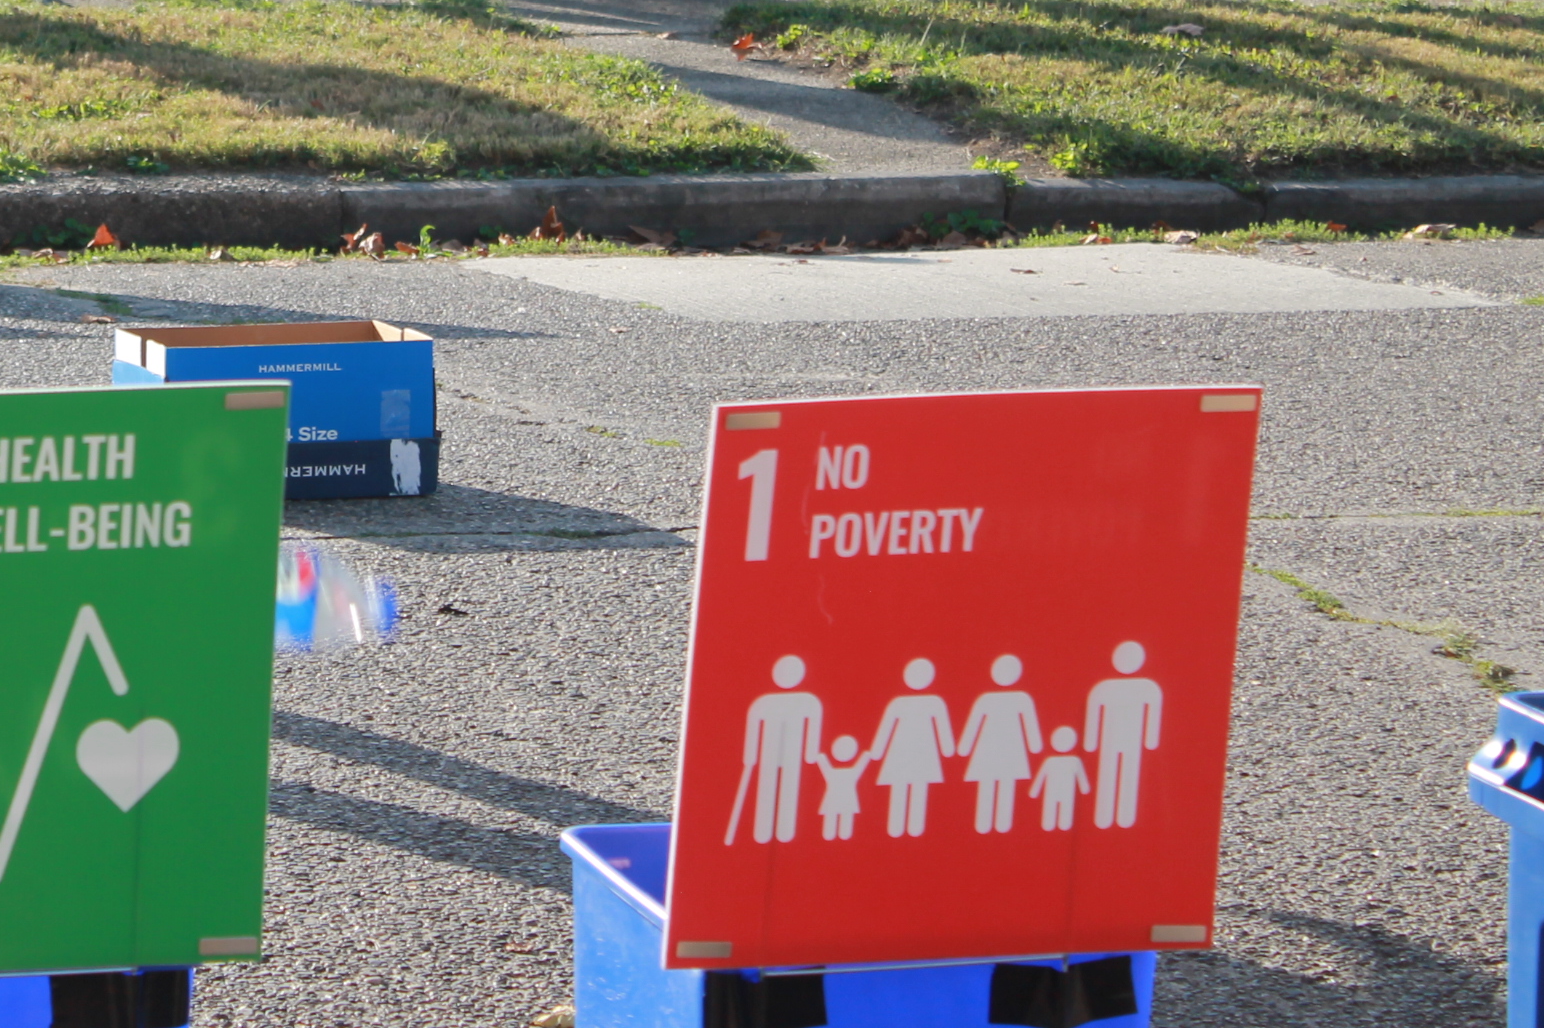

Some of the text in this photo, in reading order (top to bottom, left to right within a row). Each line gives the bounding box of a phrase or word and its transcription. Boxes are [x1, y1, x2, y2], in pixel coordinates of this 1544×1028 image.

[258, 362, 342, 374] HAMMERMILL
[298, 426, 339, 442] Size
[284, 463, 367, 478] HAMMER
[737, 443, 871, 562] 1 NO
[808, 507, 985, 560] POVERTY
